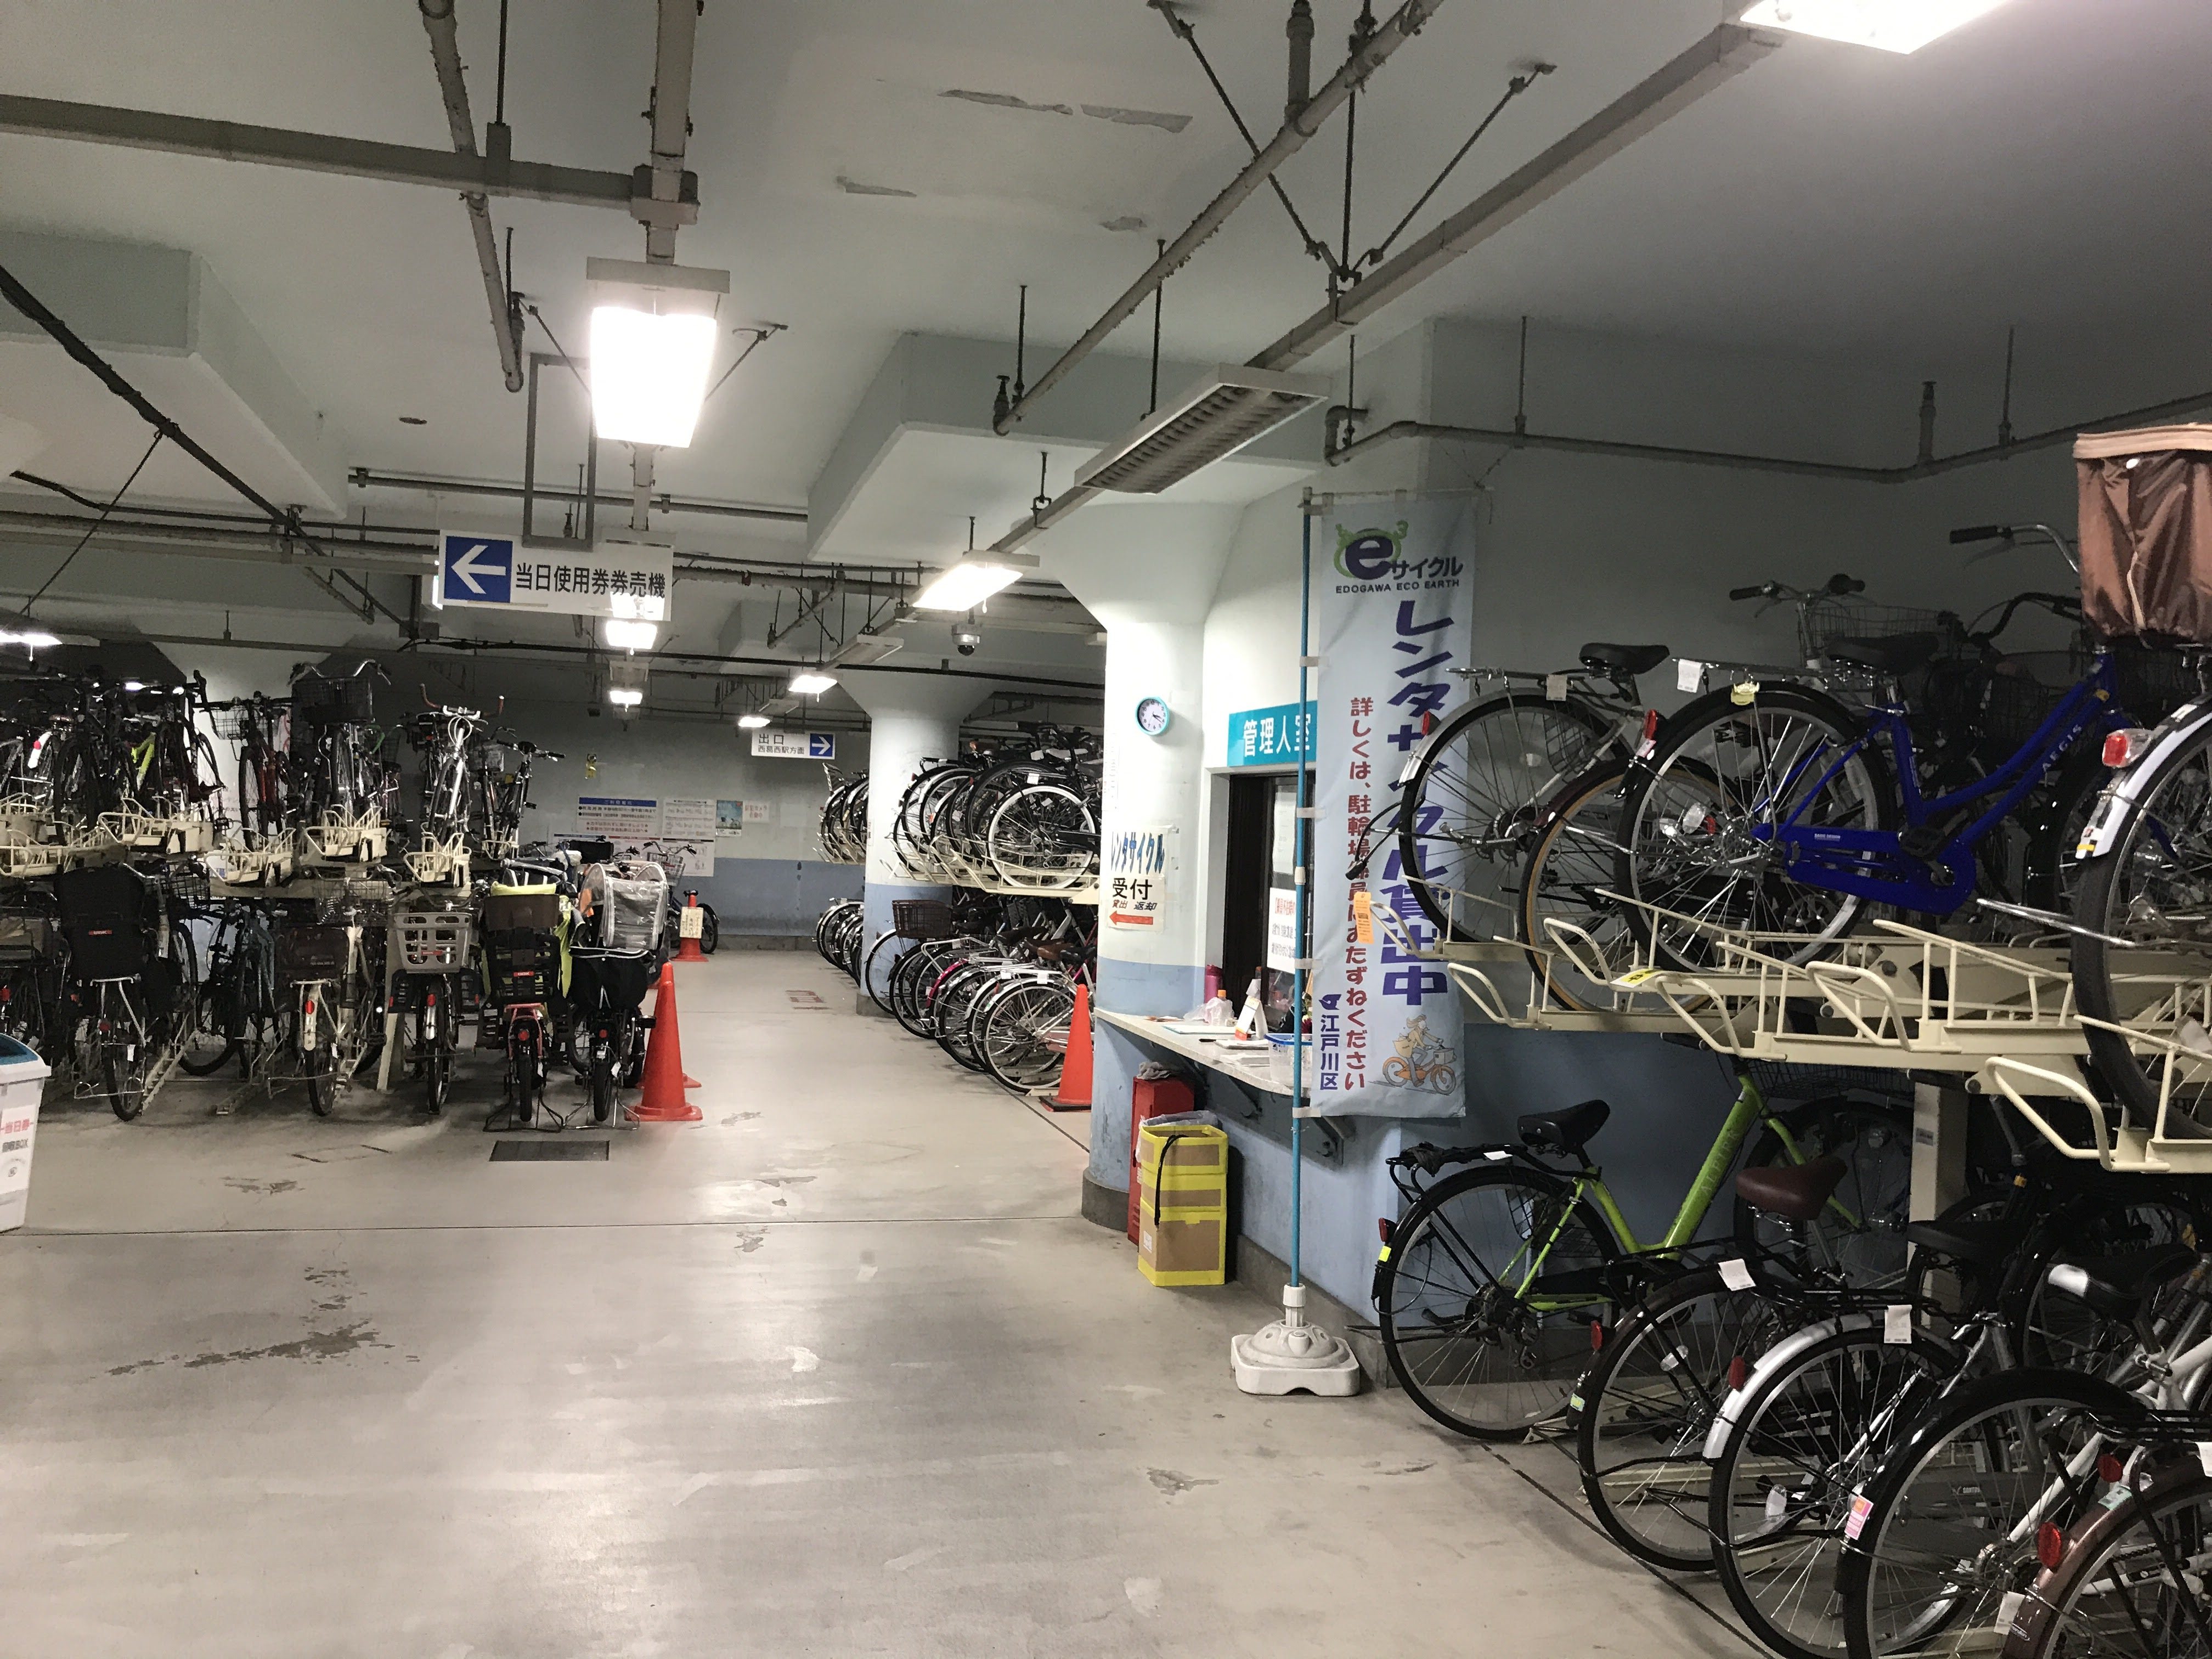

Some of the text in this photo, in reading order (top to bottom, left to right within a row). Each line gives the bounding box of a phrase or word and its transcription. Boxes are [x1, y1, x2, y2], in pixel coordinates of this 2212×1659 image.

[516, 562, 666, 599] 当日使用券券売機
[1336, 579, 1460, 594] EDOGAWA ECO EARTH
[758, 745, 805, 754] 西葛西駅方面
[759, 733, 785, 745] 出口
[2042, 724, 2083, 772] AEGIS
[1379, 600, 1454, 1005] レンタクル貸出中
[1112, 878, 1153, 900] 受付
[1112, 899, 1157, 911] 貸出 返却
[1319, 1014, 1340, 1091] 江戸川区
